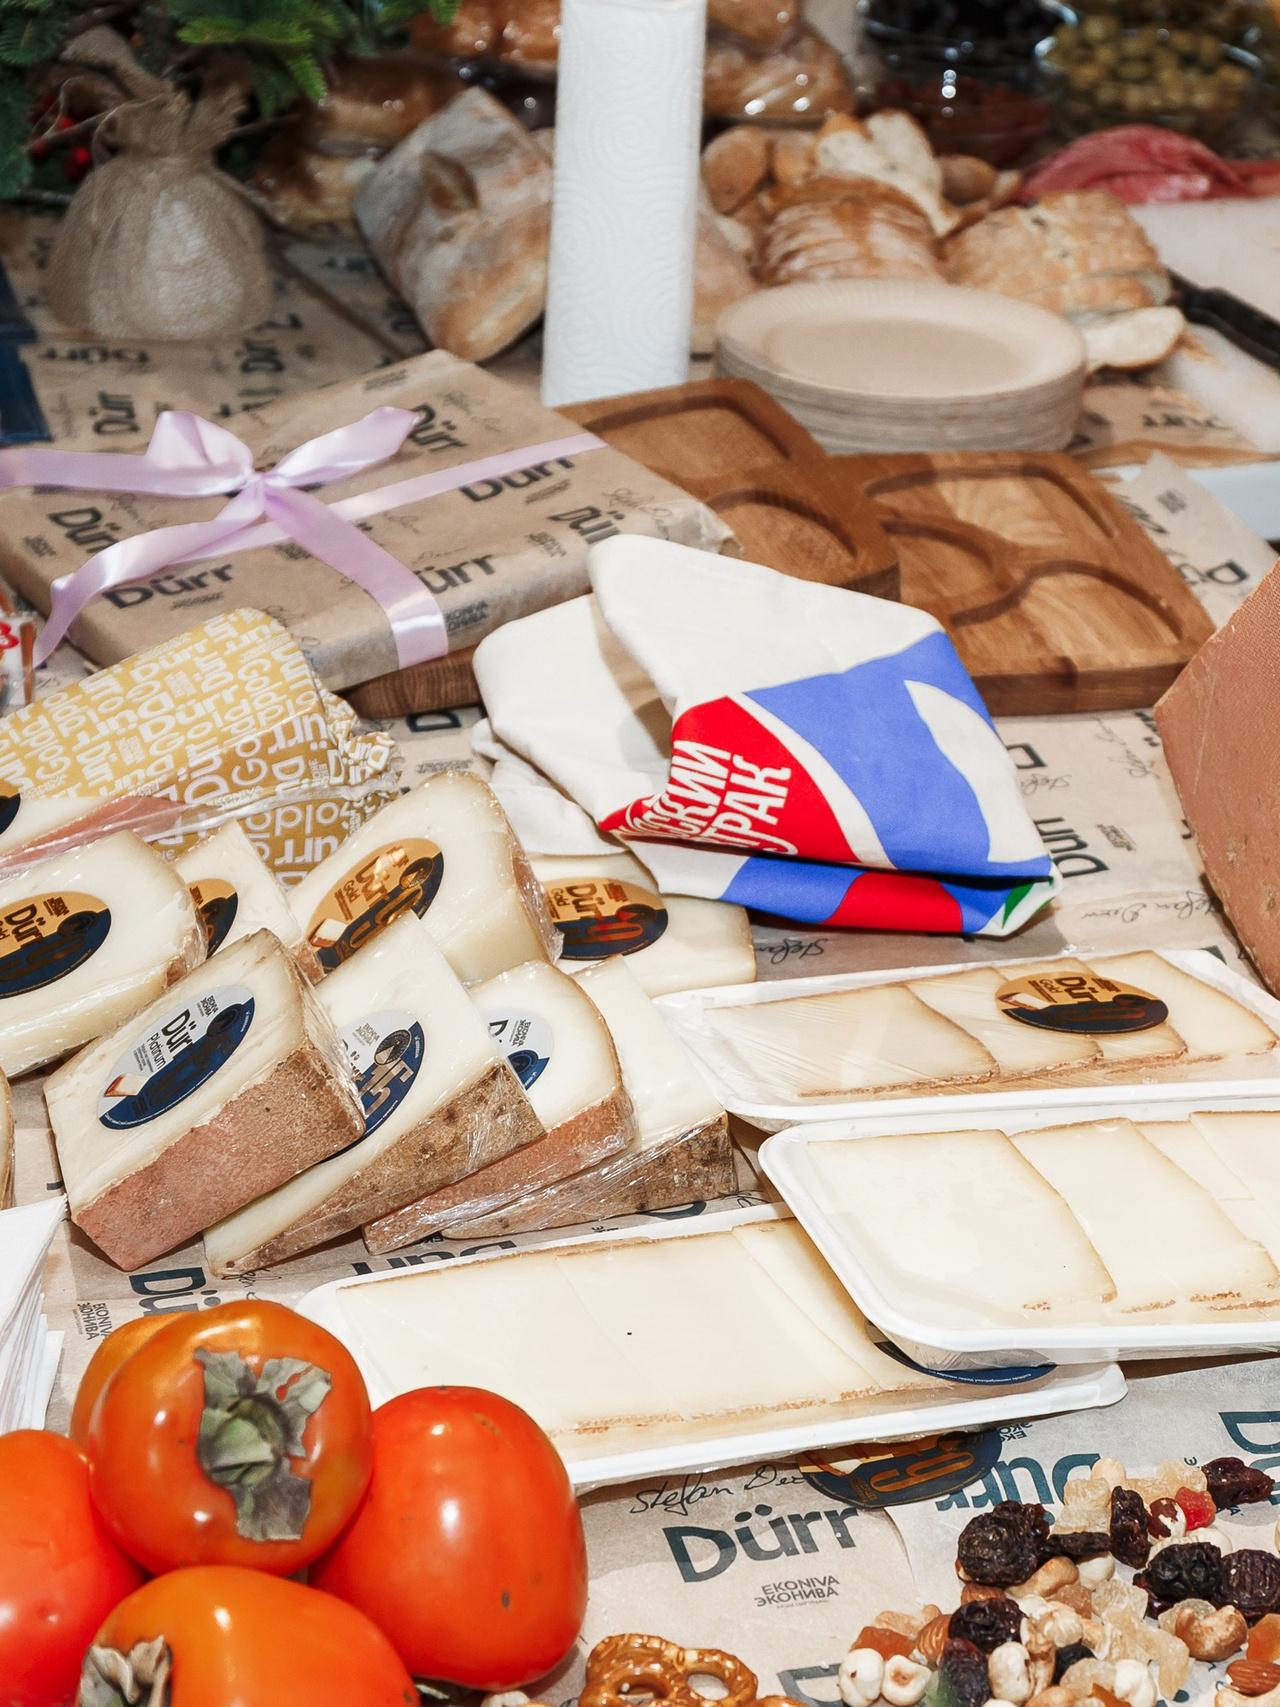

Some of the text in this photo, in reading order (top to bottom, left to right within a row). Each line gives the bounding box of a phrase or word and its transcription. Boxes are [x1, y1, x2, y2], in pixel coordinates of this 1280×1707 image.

[102, 563, 234, 610] Dürr
[412, 554, 495, 595] ürr
[129, 638, 209, 684] Dürr
[72, 691, 174, 752] Dürr
[138, 684, 239, 743] Dürr
[150, 699, 251, 757] Gold
[268, 712, 329, 754] ürr
[565, 883, 606, 921] Dürr
[4, 904, 47, 948] Dürr
[1054, 976, 1101, 1005] Dürr
[147, 1032, 167, 1070] Platinum
[161, 1009, 198, 1060] Dürr
[129, 1266, 222, 1317] Dü
[662, 1504, 861, 1583] Dürr
[754, 1585, 840, 1608] ЭКОНИВА
[761, 1575, 840, 1597] EKONIVA
